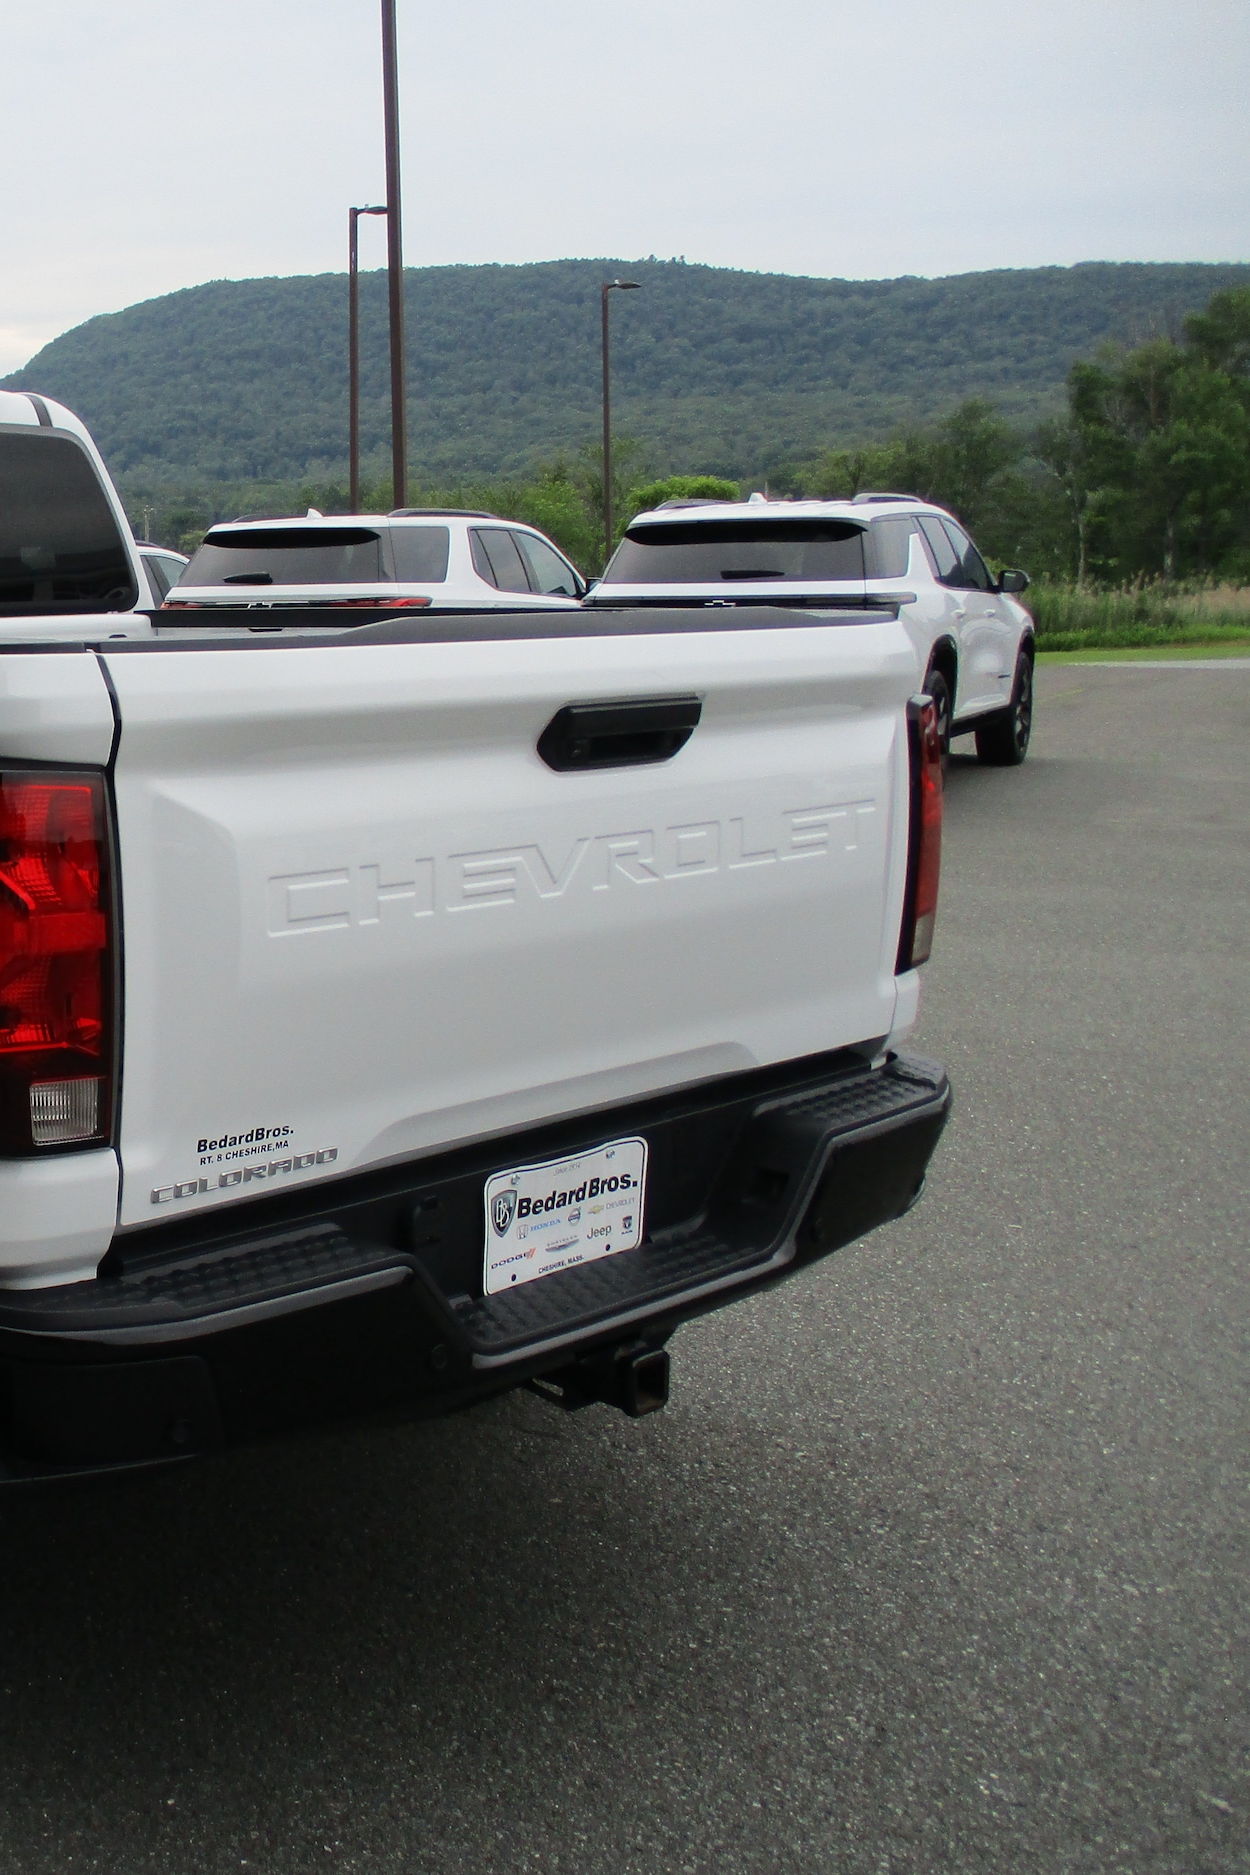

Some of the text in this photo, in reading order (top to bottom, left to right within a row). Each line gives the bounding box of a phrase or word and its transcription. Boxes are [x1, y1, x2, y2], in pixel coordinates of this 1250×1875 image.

[268, 798, 876, 937] CHEVROLET
[200, 1156, 214, 1166] RT.
[216, 1154, 223, 1162] 8
[150, 1147, 338, 1204] COLORADO
[530, 1219, 561, 1231] HONDA
[587, 1225, 612, 1239] Jeep
[491, 1251, 530, 1269] DODGE
[538, 1261, 566, 1274] CHESHIRE,
